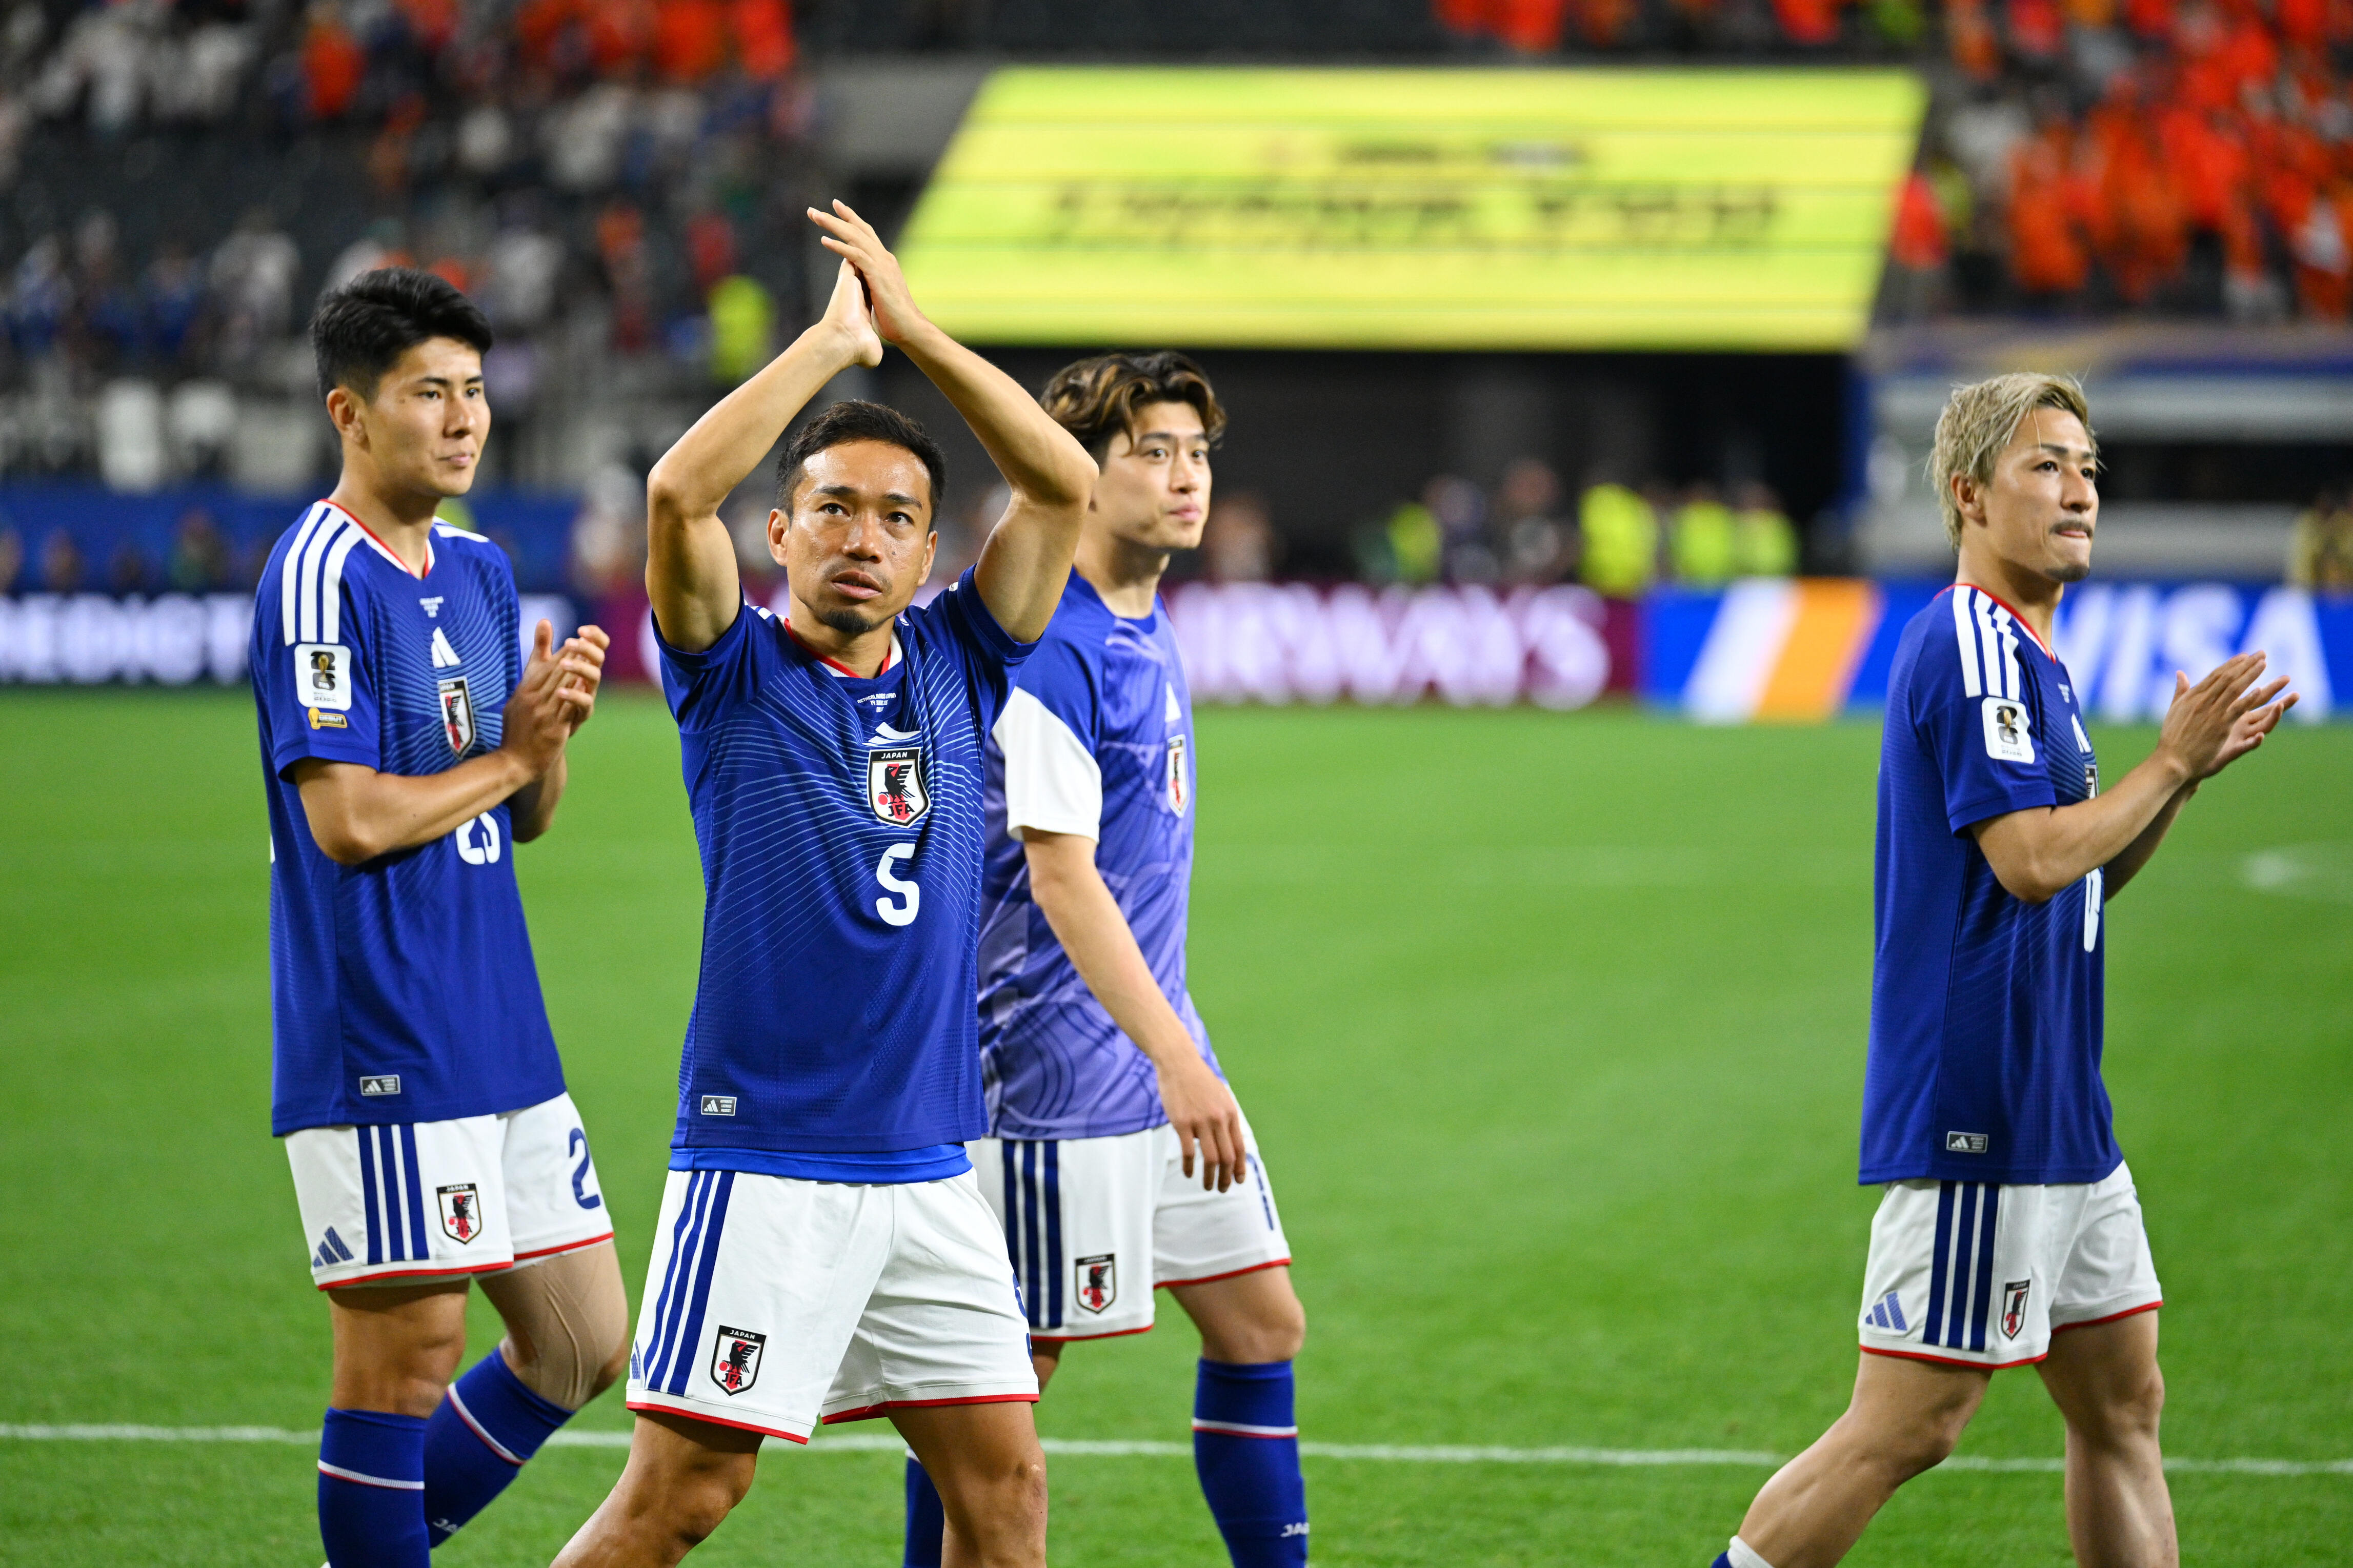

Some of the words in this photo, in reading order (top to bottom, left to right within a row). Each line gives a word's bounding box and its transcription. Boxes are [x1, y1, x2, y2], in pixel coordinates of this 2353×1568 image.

[2053, 584, 2334, 722] VISA
[888, 803, 915, 817] JFA
[876, 843, 920, 926] 5
[730, 1330, 755, 1339] JAPAN
[721, 1373, 742, 1387] JFA
